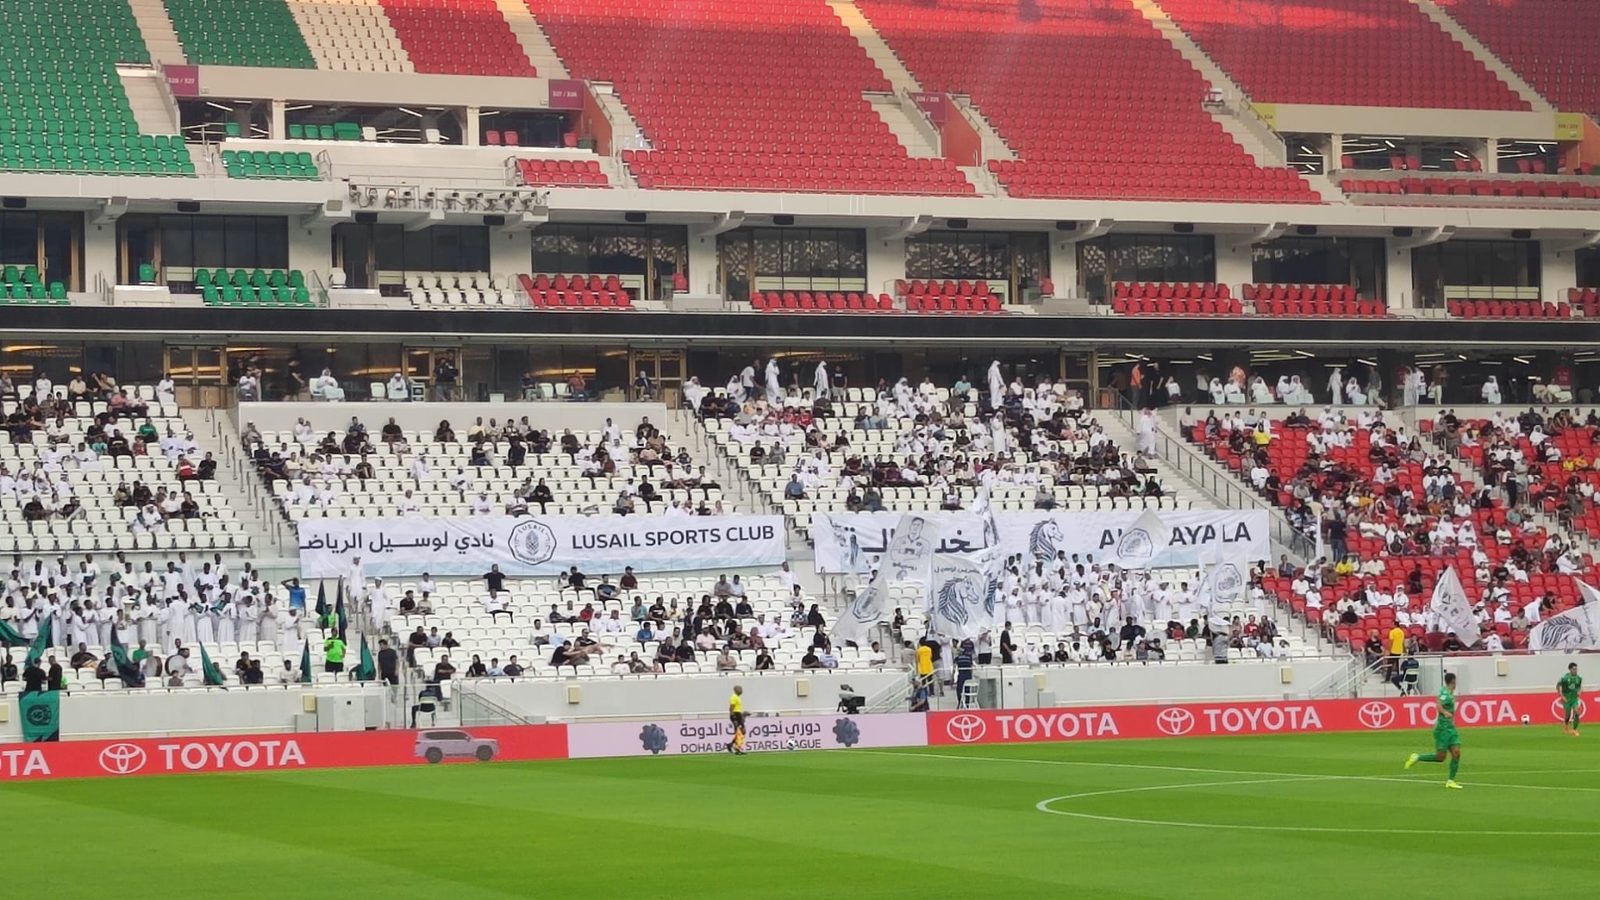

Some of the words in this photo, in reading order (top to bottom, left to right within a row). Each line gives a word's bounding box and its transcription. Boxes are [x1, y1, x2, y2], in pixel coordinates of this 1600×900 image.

[300, 532, 362, 554] الرياض
[454, 532, 494, 555] نادي
[572, 534, 641, 550] LUSAIL
[645, 529, 721, 547] SPORTS
[726, 525, 775, 542] CLUB
[1203, 705, 1323, 731] TOYOTA
[1403, 700, 1517, 726] TOOTA
[996, 712, 1119, 740] TOYOTA
[158, 740, 305, 770] TOYOTA
[681, 742, 713, 753] DOHA
[745, 741, 778, 751] STARS
[781, 738, 822, 750] LAGUE
